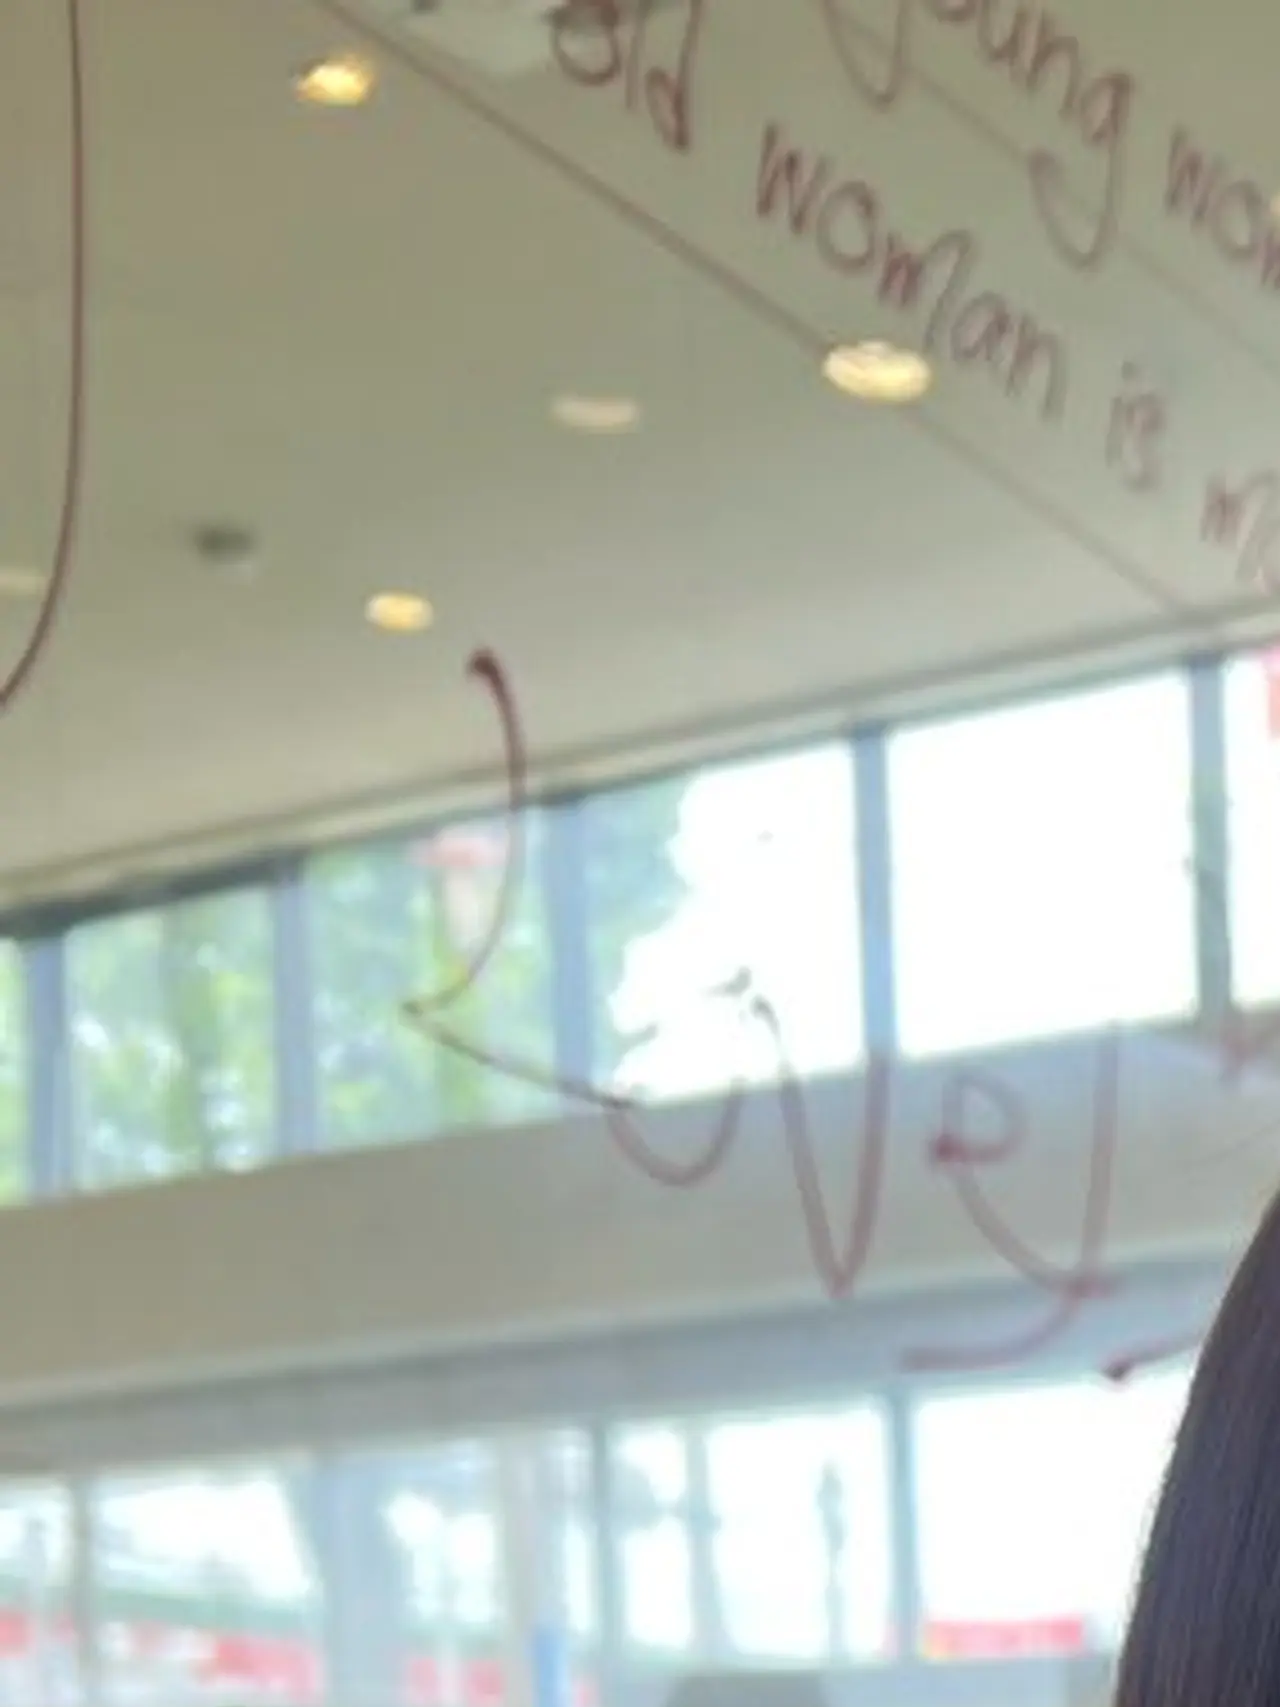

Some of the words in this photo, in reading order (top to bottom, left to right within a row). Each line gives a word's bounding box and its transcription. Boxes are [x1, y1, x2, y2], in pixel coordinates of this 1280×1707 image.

[820, 0, 1134, 272] ung
[756, 120, 1066, 422] woman
[1104, 358, 1166, 494] is
